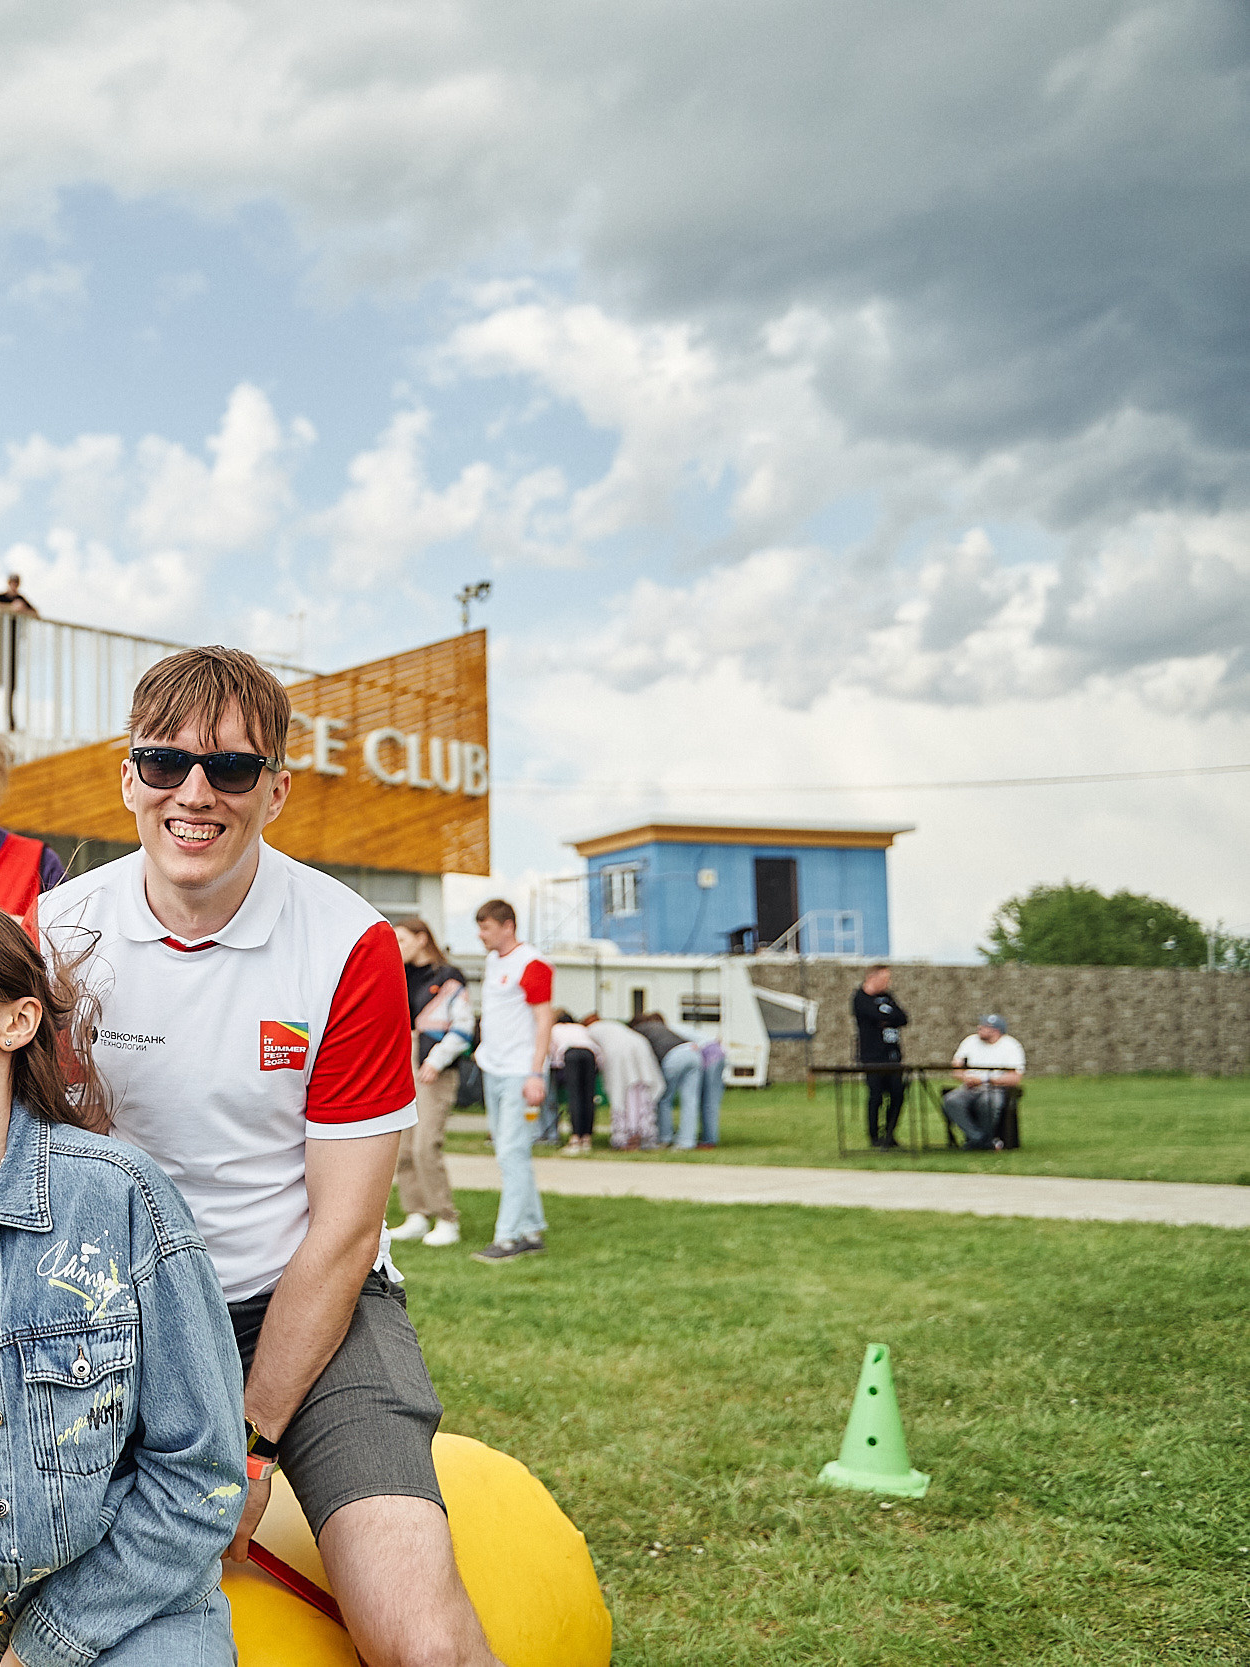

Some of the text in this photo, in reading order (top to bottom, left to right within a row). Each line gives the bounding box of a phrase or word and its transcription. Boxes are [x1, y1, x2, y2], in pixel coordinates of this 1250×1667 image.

[285, 711, 488, 796] CE CLUB
[100, 1029, 166, 1044] СОВКОМБАНК
[100, 1038, 147, 1051] ТЕХНОЛОГИИ
[263, 1045, 306, 1053] SUMMER
[263, 1058, 290, 1067] 2023
